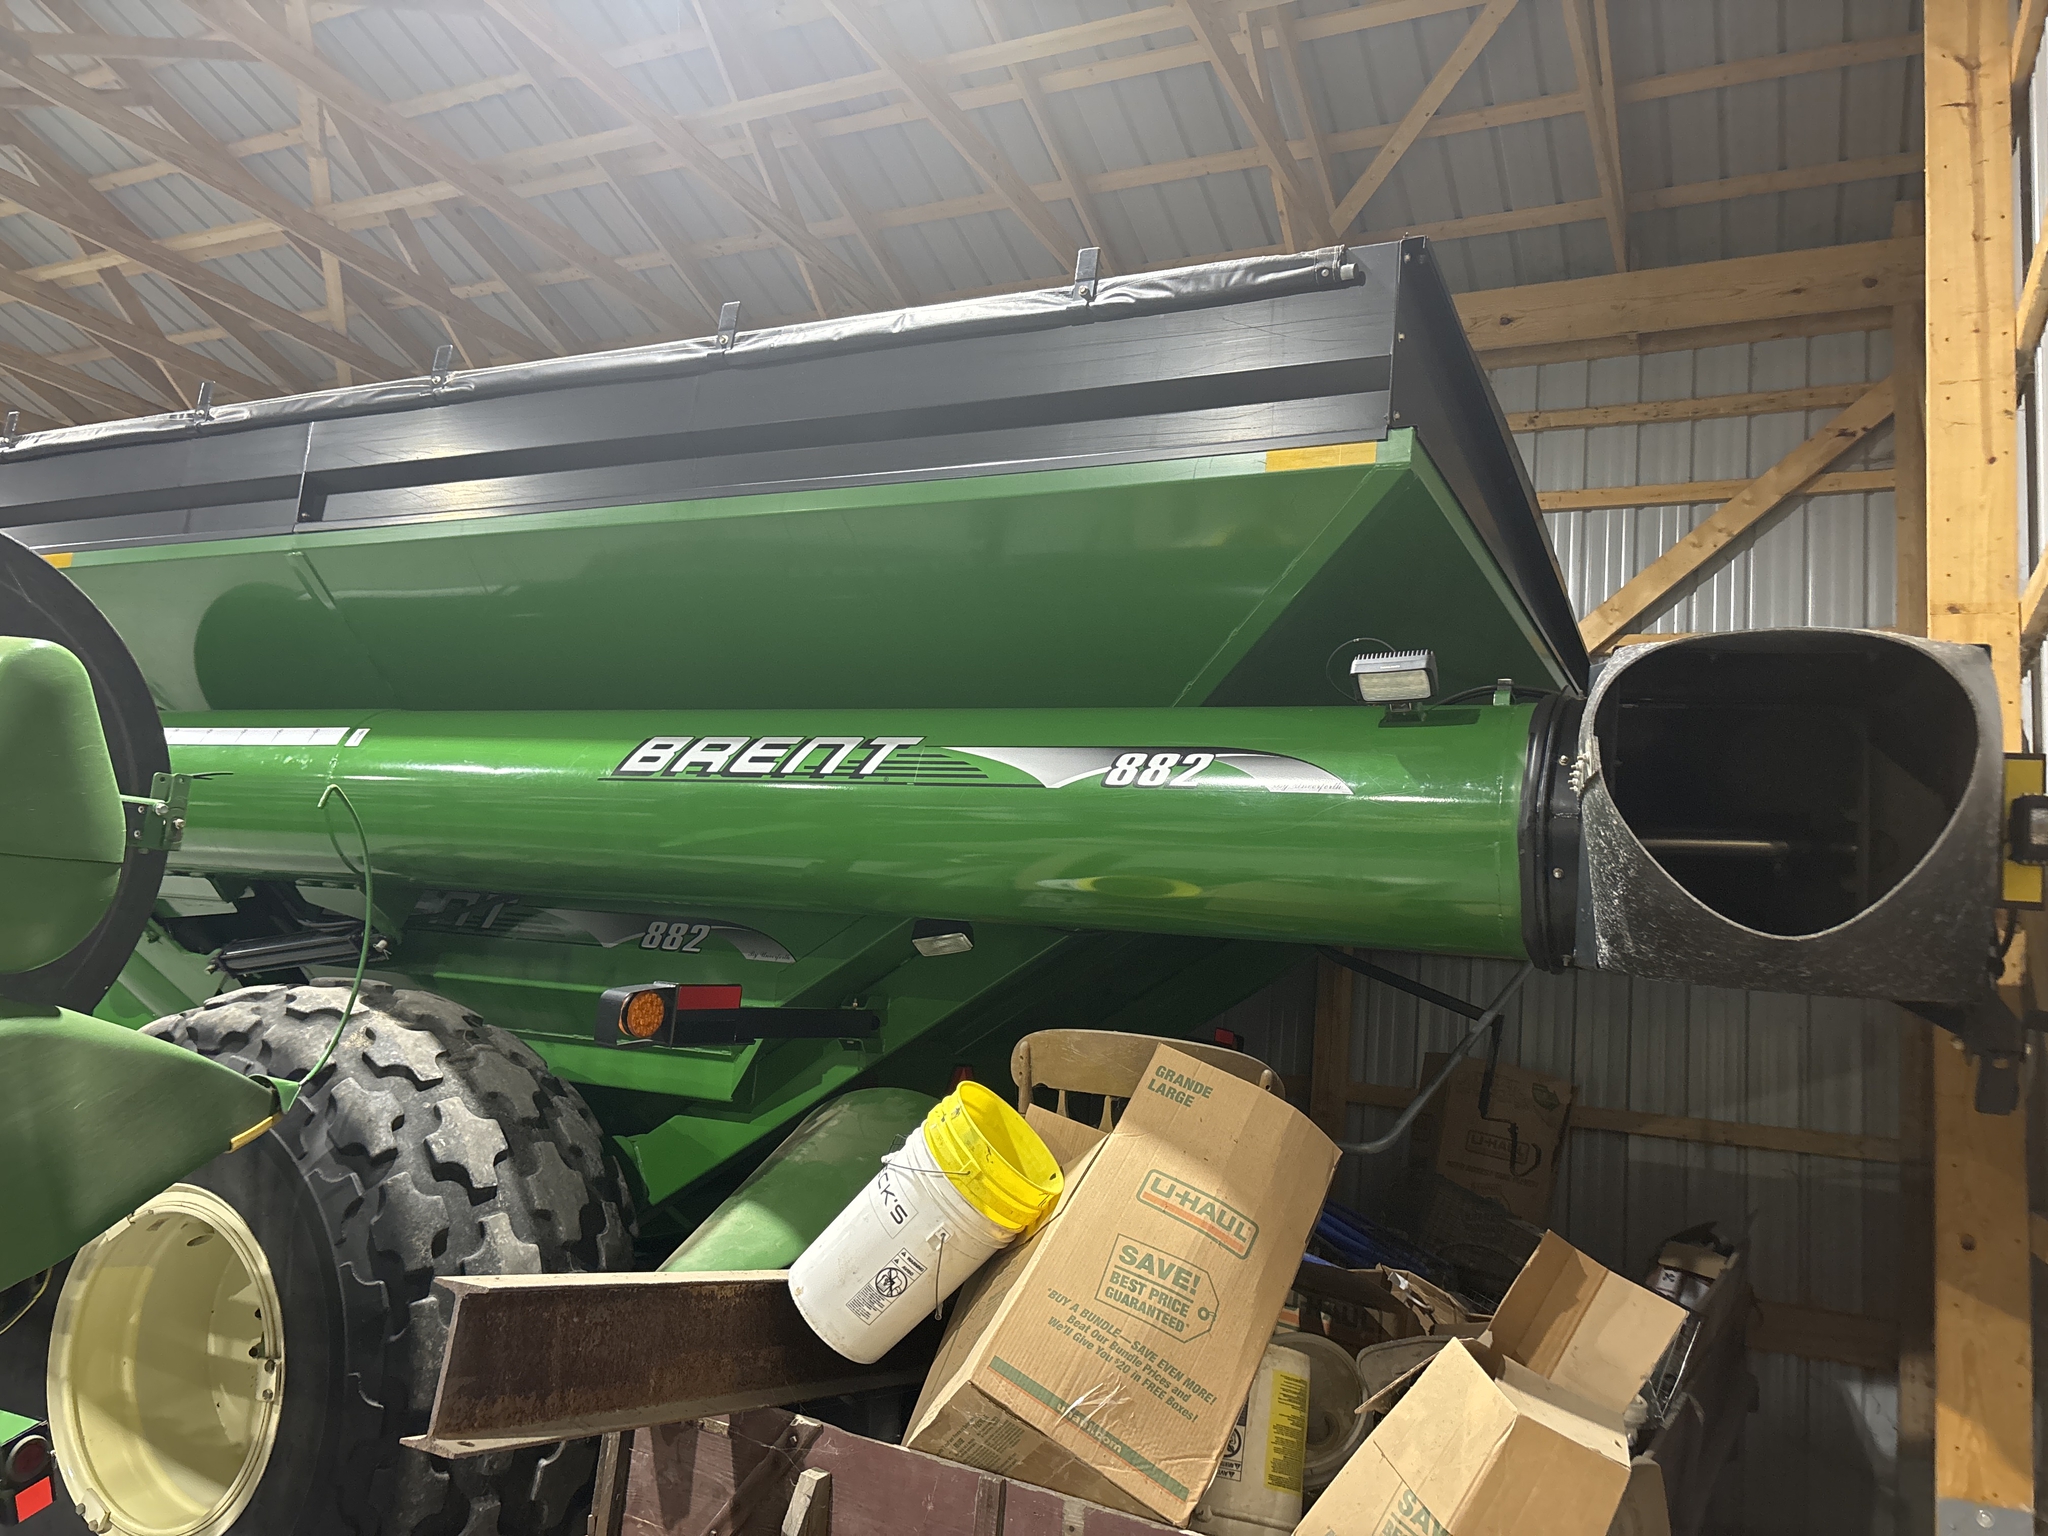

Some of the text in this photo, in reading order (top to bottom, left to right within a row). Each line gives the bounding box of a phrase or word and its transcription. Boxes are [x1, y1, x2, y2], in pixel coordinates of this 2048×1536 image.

[614, 735, 927, 777] BRENT
[1102, 751, 1216, 788] 882
[639, 921, 712, 954] 882
[1147, 1078, 1196, 1108] LARGE
[1155, 1065, 1214, 1099] GRANDE
[877, 1166, 909, 1225] CK'S
[1150, 1176, 1249, 1244] U-HAUL
[1109, 1270, 1191, 1318] BEST PRICE
[1118, 1244, 1201, 1296] SAVE!
[1047, 1315, 1199, 1423] We'll Give You $20 in FREE Boxes!
[1066, 1314, 1193, 1403] Beat Our Bundle Prices and
[1069, 1303, 1080, 1313] A
[1156, 1358, 1185, 1382] EVEN
[1182, 1377, 1218, 1406] MORE!
